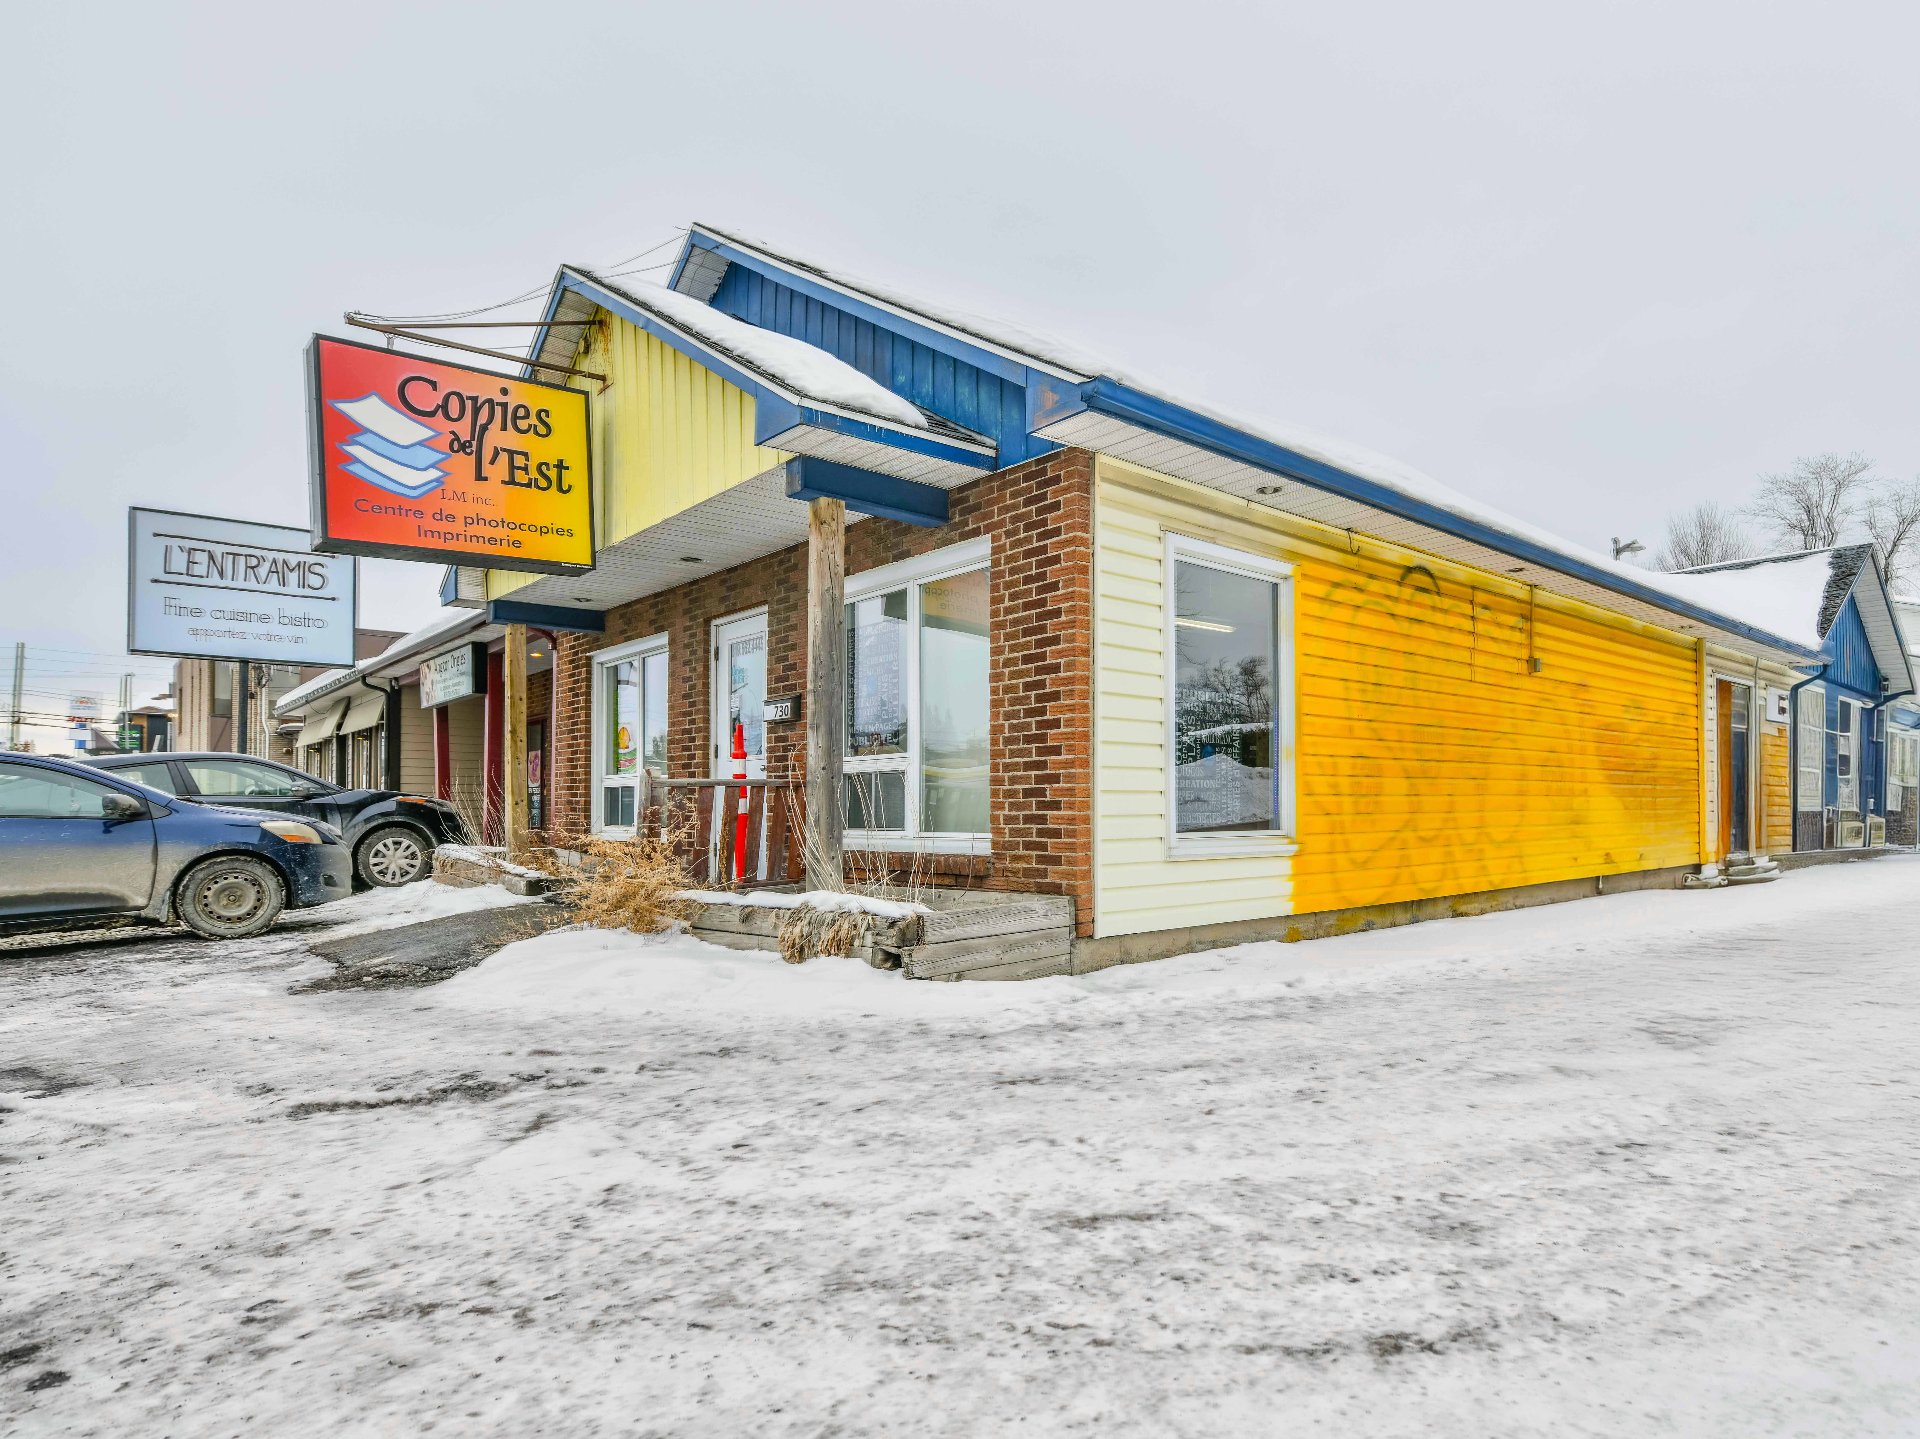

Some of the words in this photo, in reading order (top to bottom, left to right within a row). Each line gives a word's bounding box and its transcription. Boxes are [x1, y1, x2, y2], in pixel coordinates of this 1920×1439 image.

[397, 375, 552, 441] Copies
[449, 430, 473, 456] de
[472, 493, 496, 507] inc.
[353, 498, 424, 519] Centre
[432, 507, 456, 522] de
[463, 512, 574, 538] photocopies
[417, 524, 523, 549] Imprimerie
[163, 596, 204, 618] Fine
[210, 608, 272, 625] cuisine
[278, 608, 326, 629] bistro
[774, 704, 789, 718] 730
